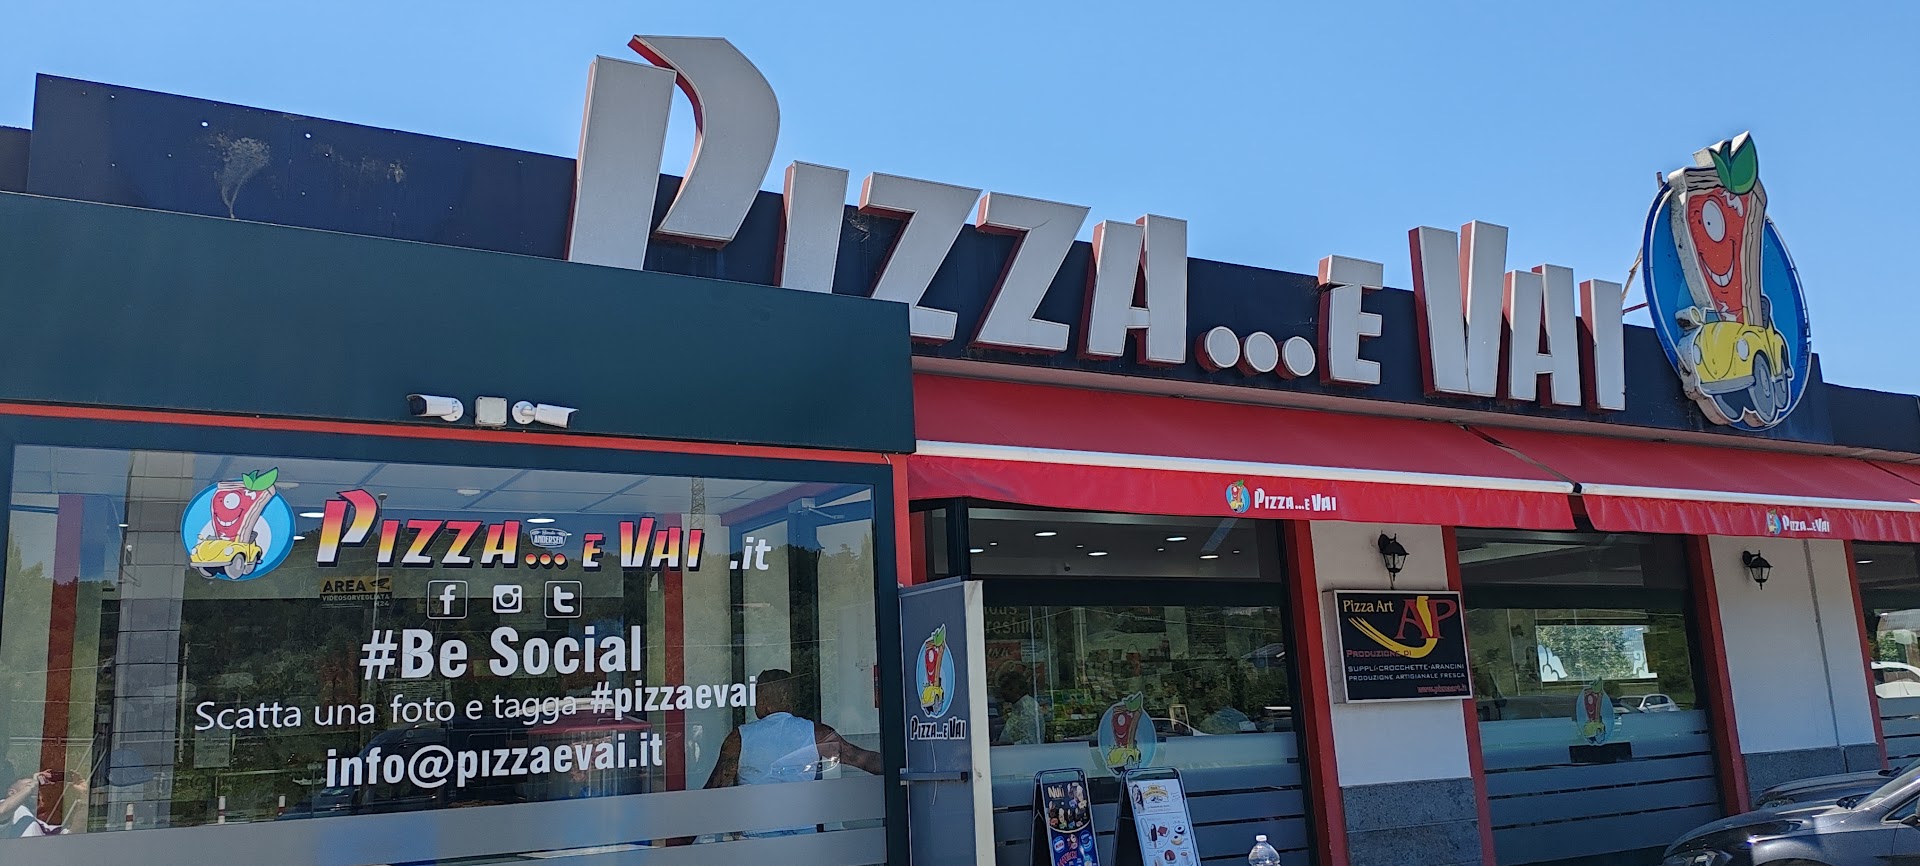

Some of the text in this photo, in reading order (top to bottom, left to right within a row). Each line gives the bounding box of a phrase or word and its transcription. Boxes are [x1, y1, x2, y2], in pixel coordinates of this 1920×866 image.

[1408, 220, 1626, 413] VAI
[1311, 494, 1337, 511] VAI
[619, 516, 705, 571] VAI
[323, 580, 366, 593] AREA
[322, 593, 390, 602] VIDEOSORVEGLIATA
[1343, 599, 1395, 613] Pizza Art
[359, 625, 641, 681] #Be Social
[1346, 649, 1401, 658] PRODUZIONE
[1395, 673, 1438, 681] ARTIGIANALE
[194, 675, 757, 731] Scatta una foto e tagga #pizzaevai
[949, 716, 966, 740] VAI
